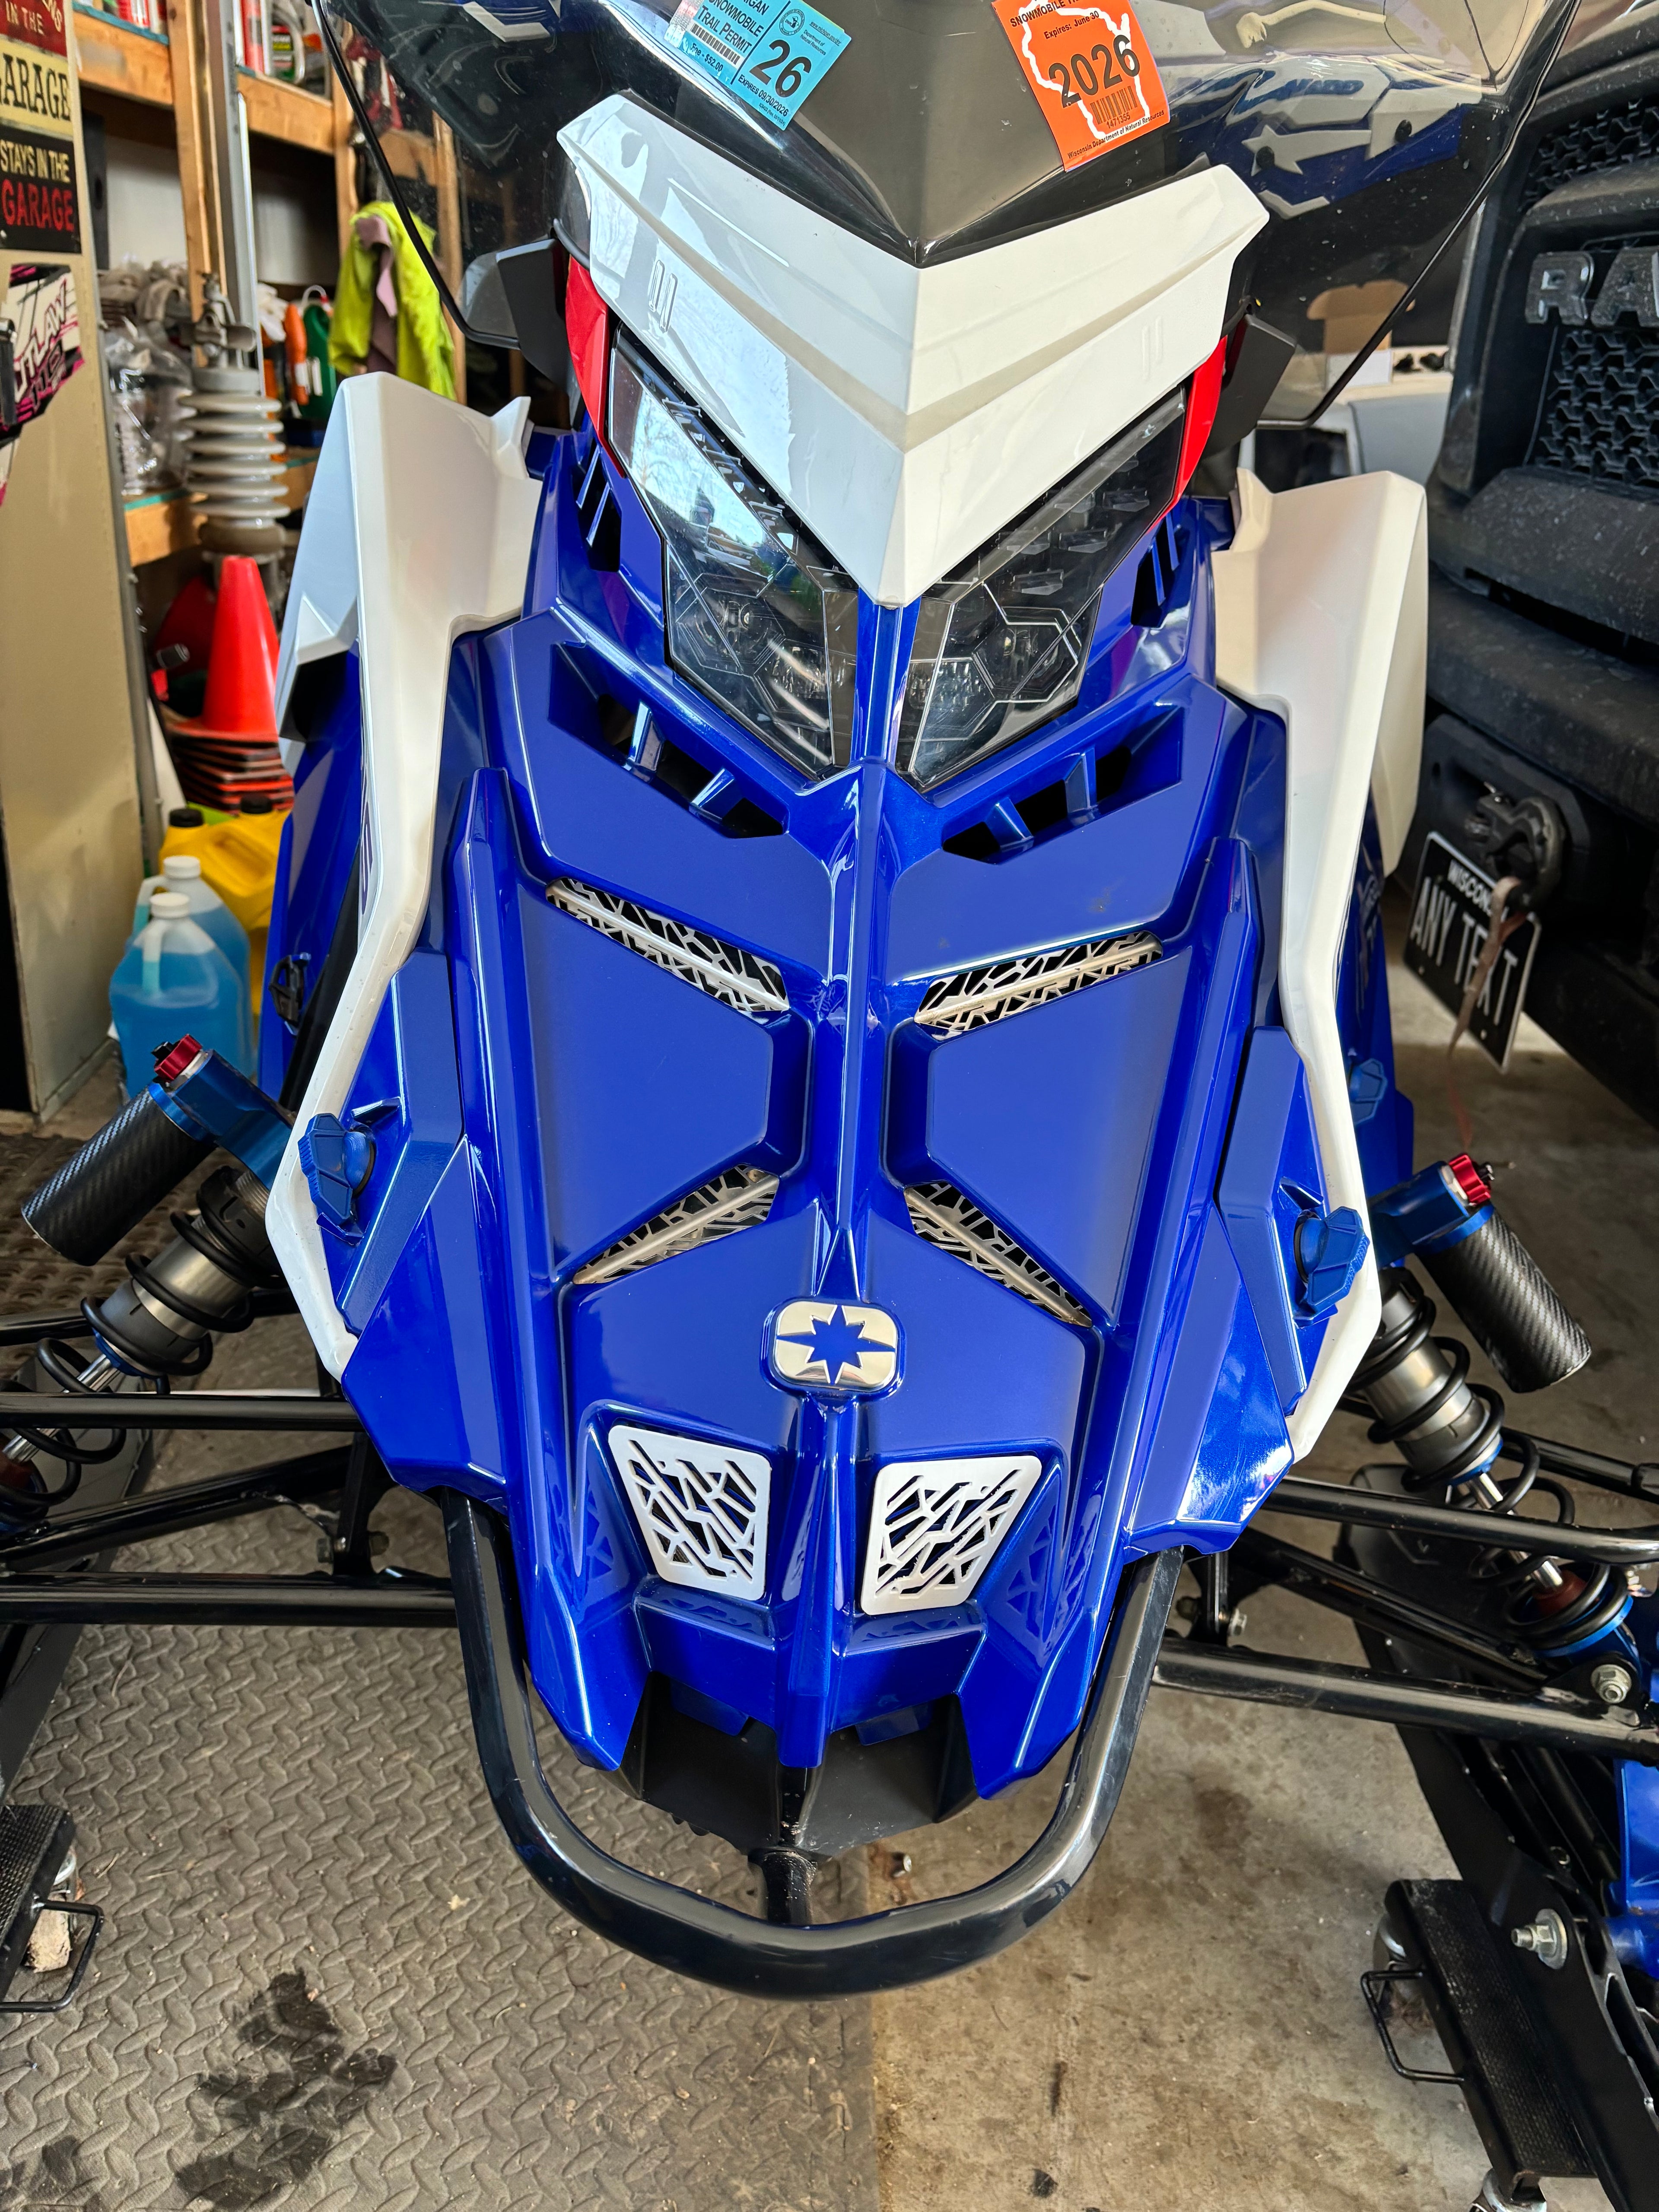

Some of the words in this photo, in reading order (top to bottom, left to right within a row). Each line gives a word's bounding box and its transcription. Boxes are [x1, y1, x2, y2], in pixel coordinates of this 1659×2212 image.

[6, 0, 19, 25] IN
[21, 6, 44, 35] THE
[698, 5, 720, 33] TRAIL
[719, 22, 752, 54] PERMIT
[1010, 0, 1066, 27] SNOWMOBILE
[1044, 24, 1072, 40] Expires:
[1074, 16, 1090, 27] June
[1090, 10, 1099, 20] 30
[704, 54, 724, 72] $52.00
[749, 39, 812, 98] 26
[1049, 35, 1140, 108] 2026
[0, 52, 71, 122] ARAGE
[738, 74, 760, 95] EXPIRES
[758, 89, 789, 117] 09/30/2026
[1068, 144, 1092, 159] Wisconsin
[1092, 130, 1119, 148] Department
[1125, 120, 1142, 131] Natural
[1142, 110, 1165, 124] Resources
[1106, 112, 1131, 129] 1471355
[0, 139, 35, 178] STAYS
[36, 147, 48, 179] IN
[48, 150, 71, 184] THE
[1, 179, 75, 232] GARAGE
[1409, 877, 1458, 967] ANY
